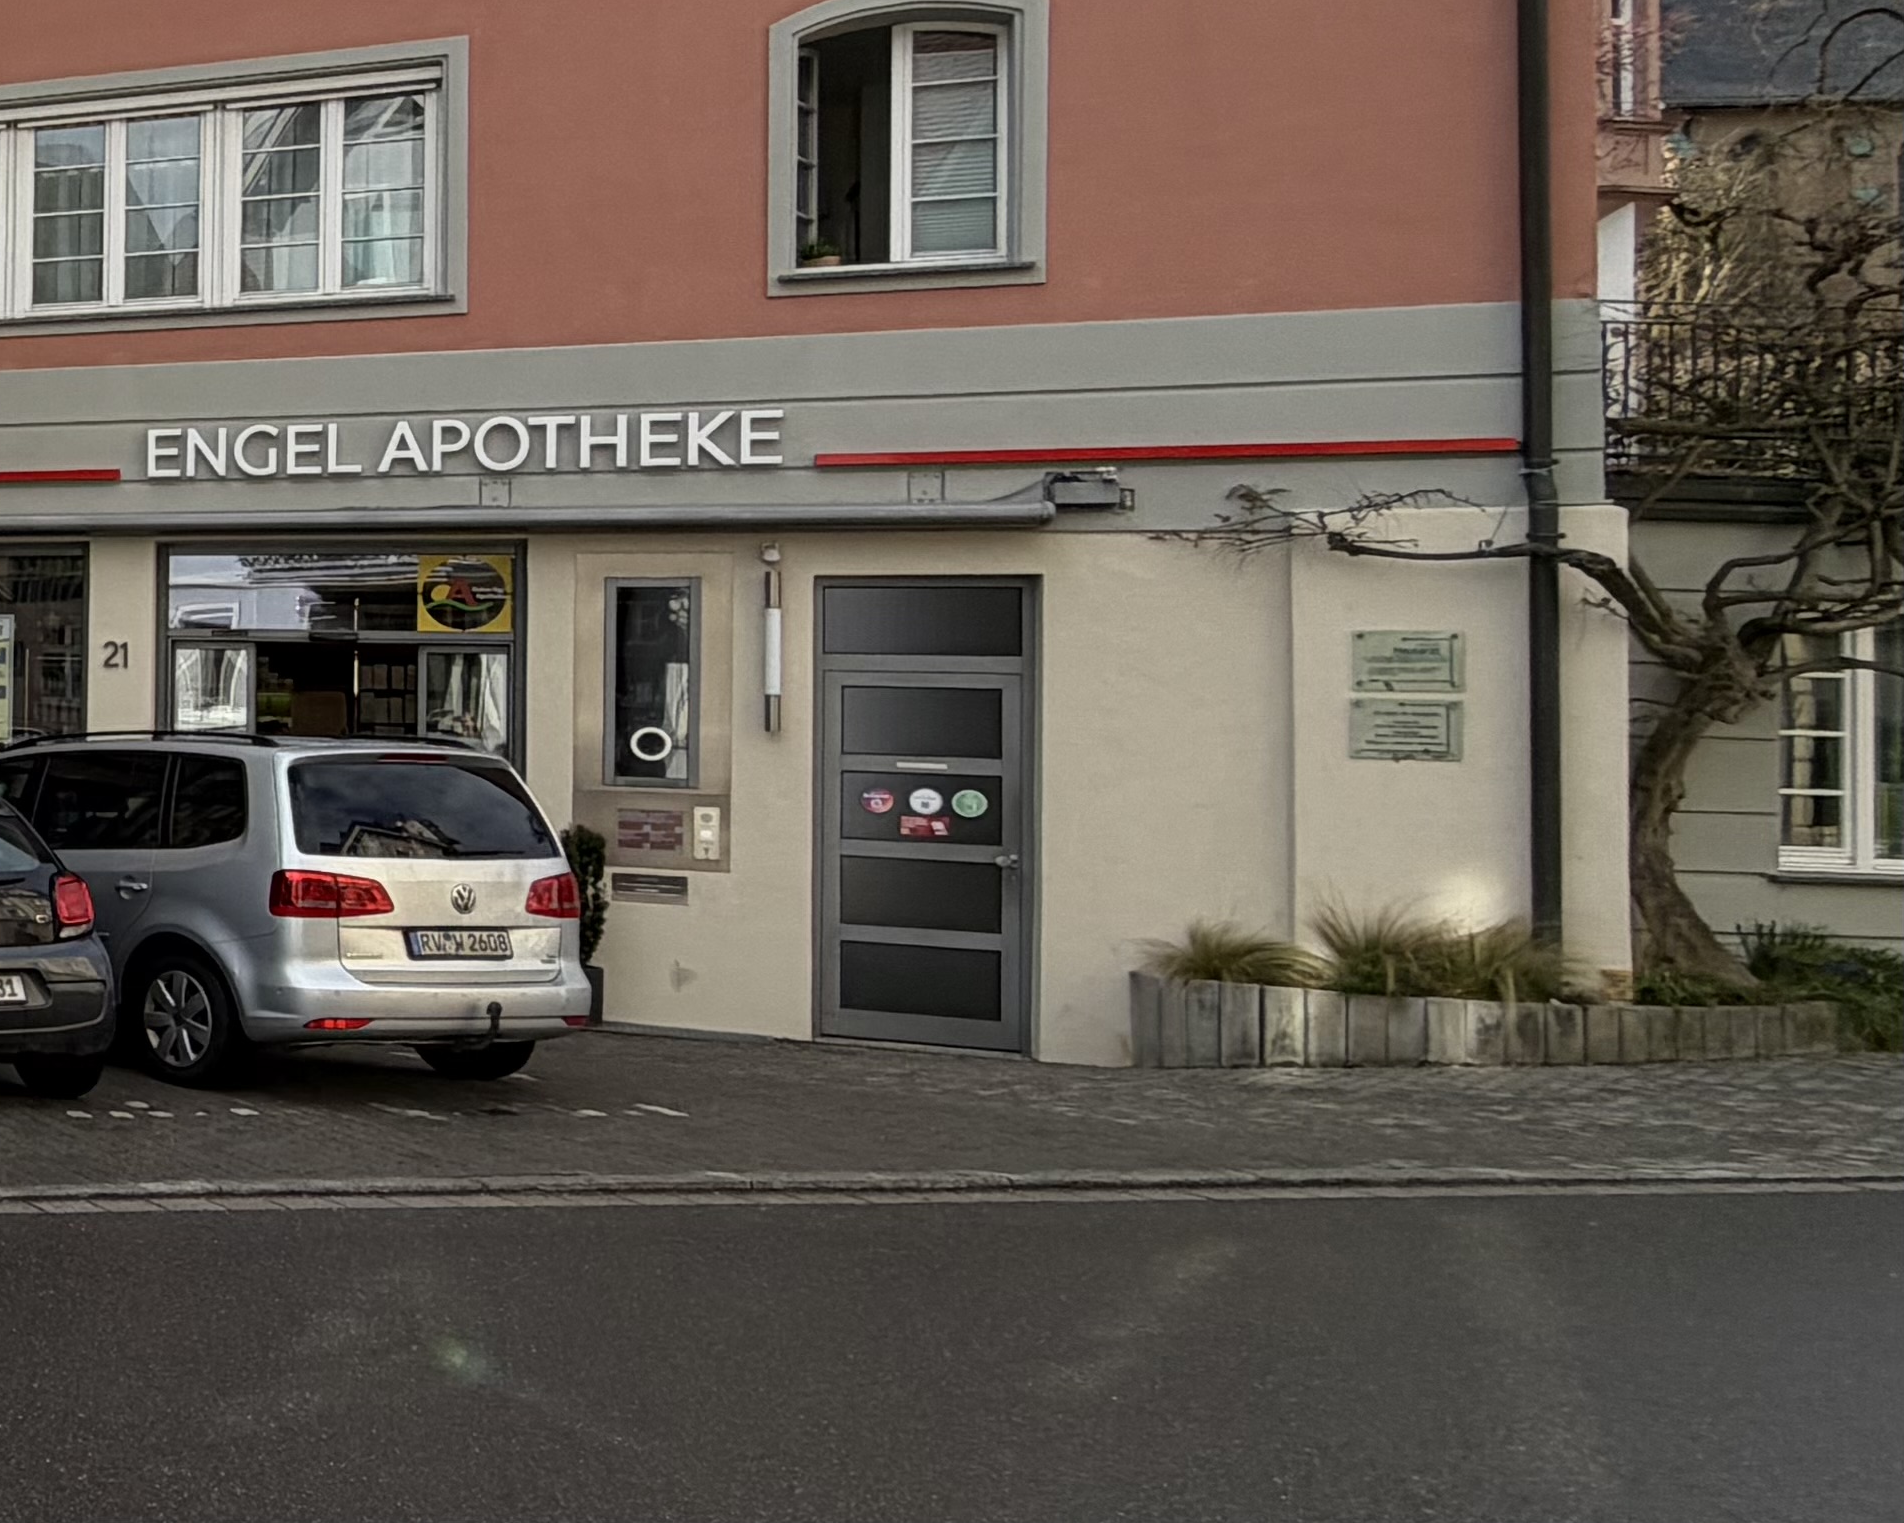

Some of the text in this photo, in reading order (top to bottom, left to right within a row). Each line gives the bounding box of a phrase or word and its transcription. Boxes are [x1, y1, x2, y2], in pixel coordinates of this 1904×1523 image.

[145, 409, 785, 477] ENGEL APOTHEKE
[103, 640, 129, 670] 21
[420, 933, 443, 953] RV
[468, 933, 509, 953] 2608
